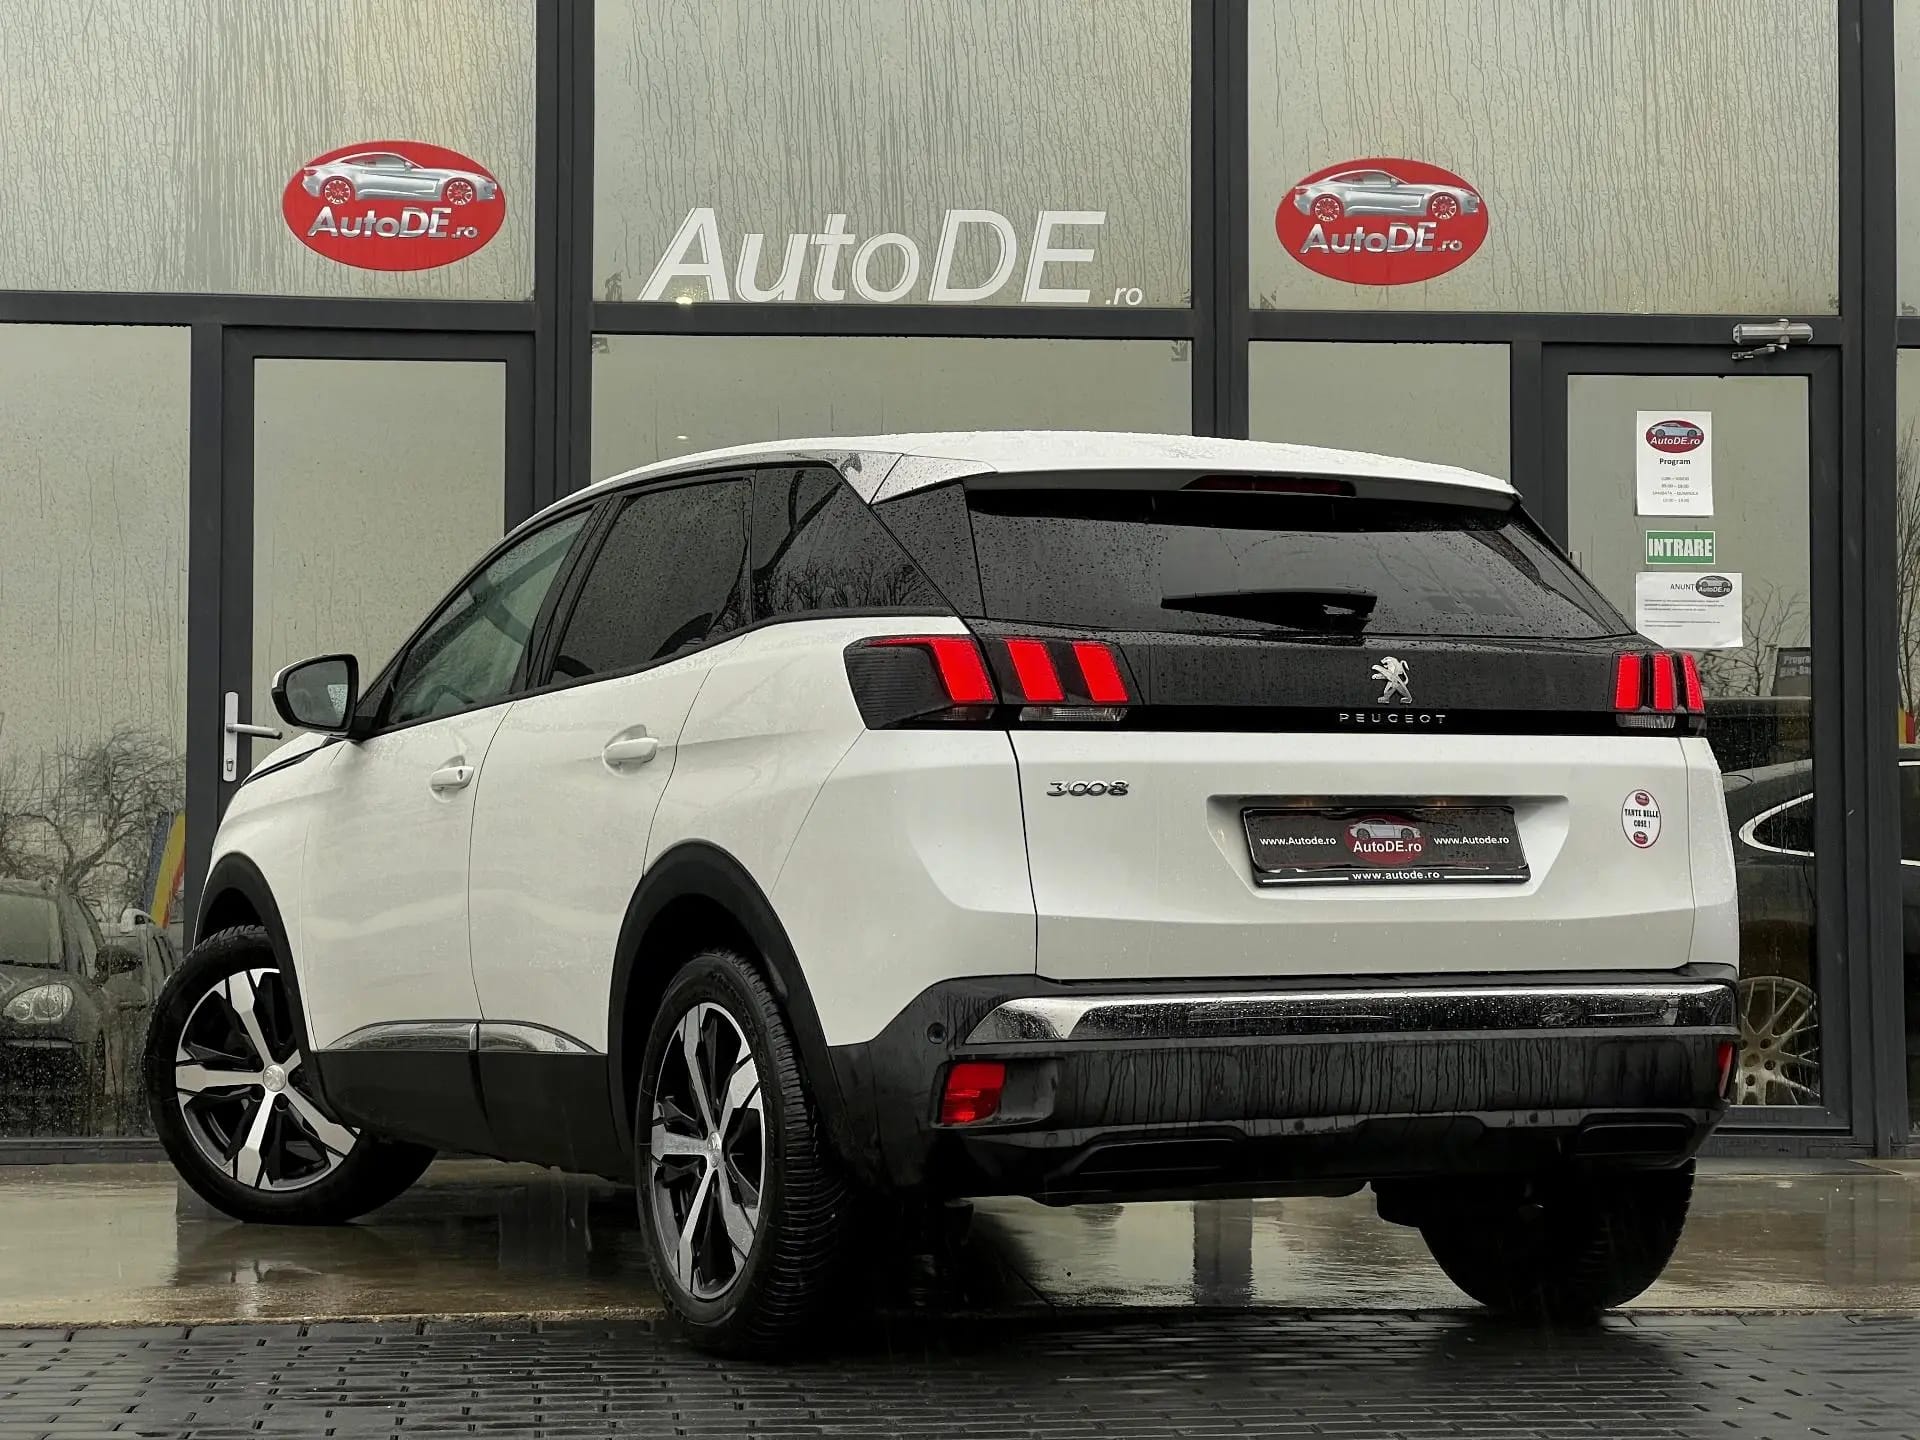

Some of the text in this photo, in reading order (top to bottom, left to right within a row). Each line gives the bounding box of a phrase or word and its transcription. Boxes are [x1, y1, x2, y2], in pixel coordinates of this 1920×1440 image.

[1650, 436, 1701, 446] AutoDE.ro
[1659, 458, 1691, 466] Program
[1648, 538, 1713, 557] INTRARE
[1338, 713, 1447, 724] PEUGEOT
[1046, 780, 1130, 797] 3008
[1259, 836, 1337, 847] www.Autode.ro
[1433, 835, 1510, 846] www.Autode.ro
[1353, 840, 1423, 854] AutoDE.ro
[1351, 870, 1441, 881] www.autode.ro
